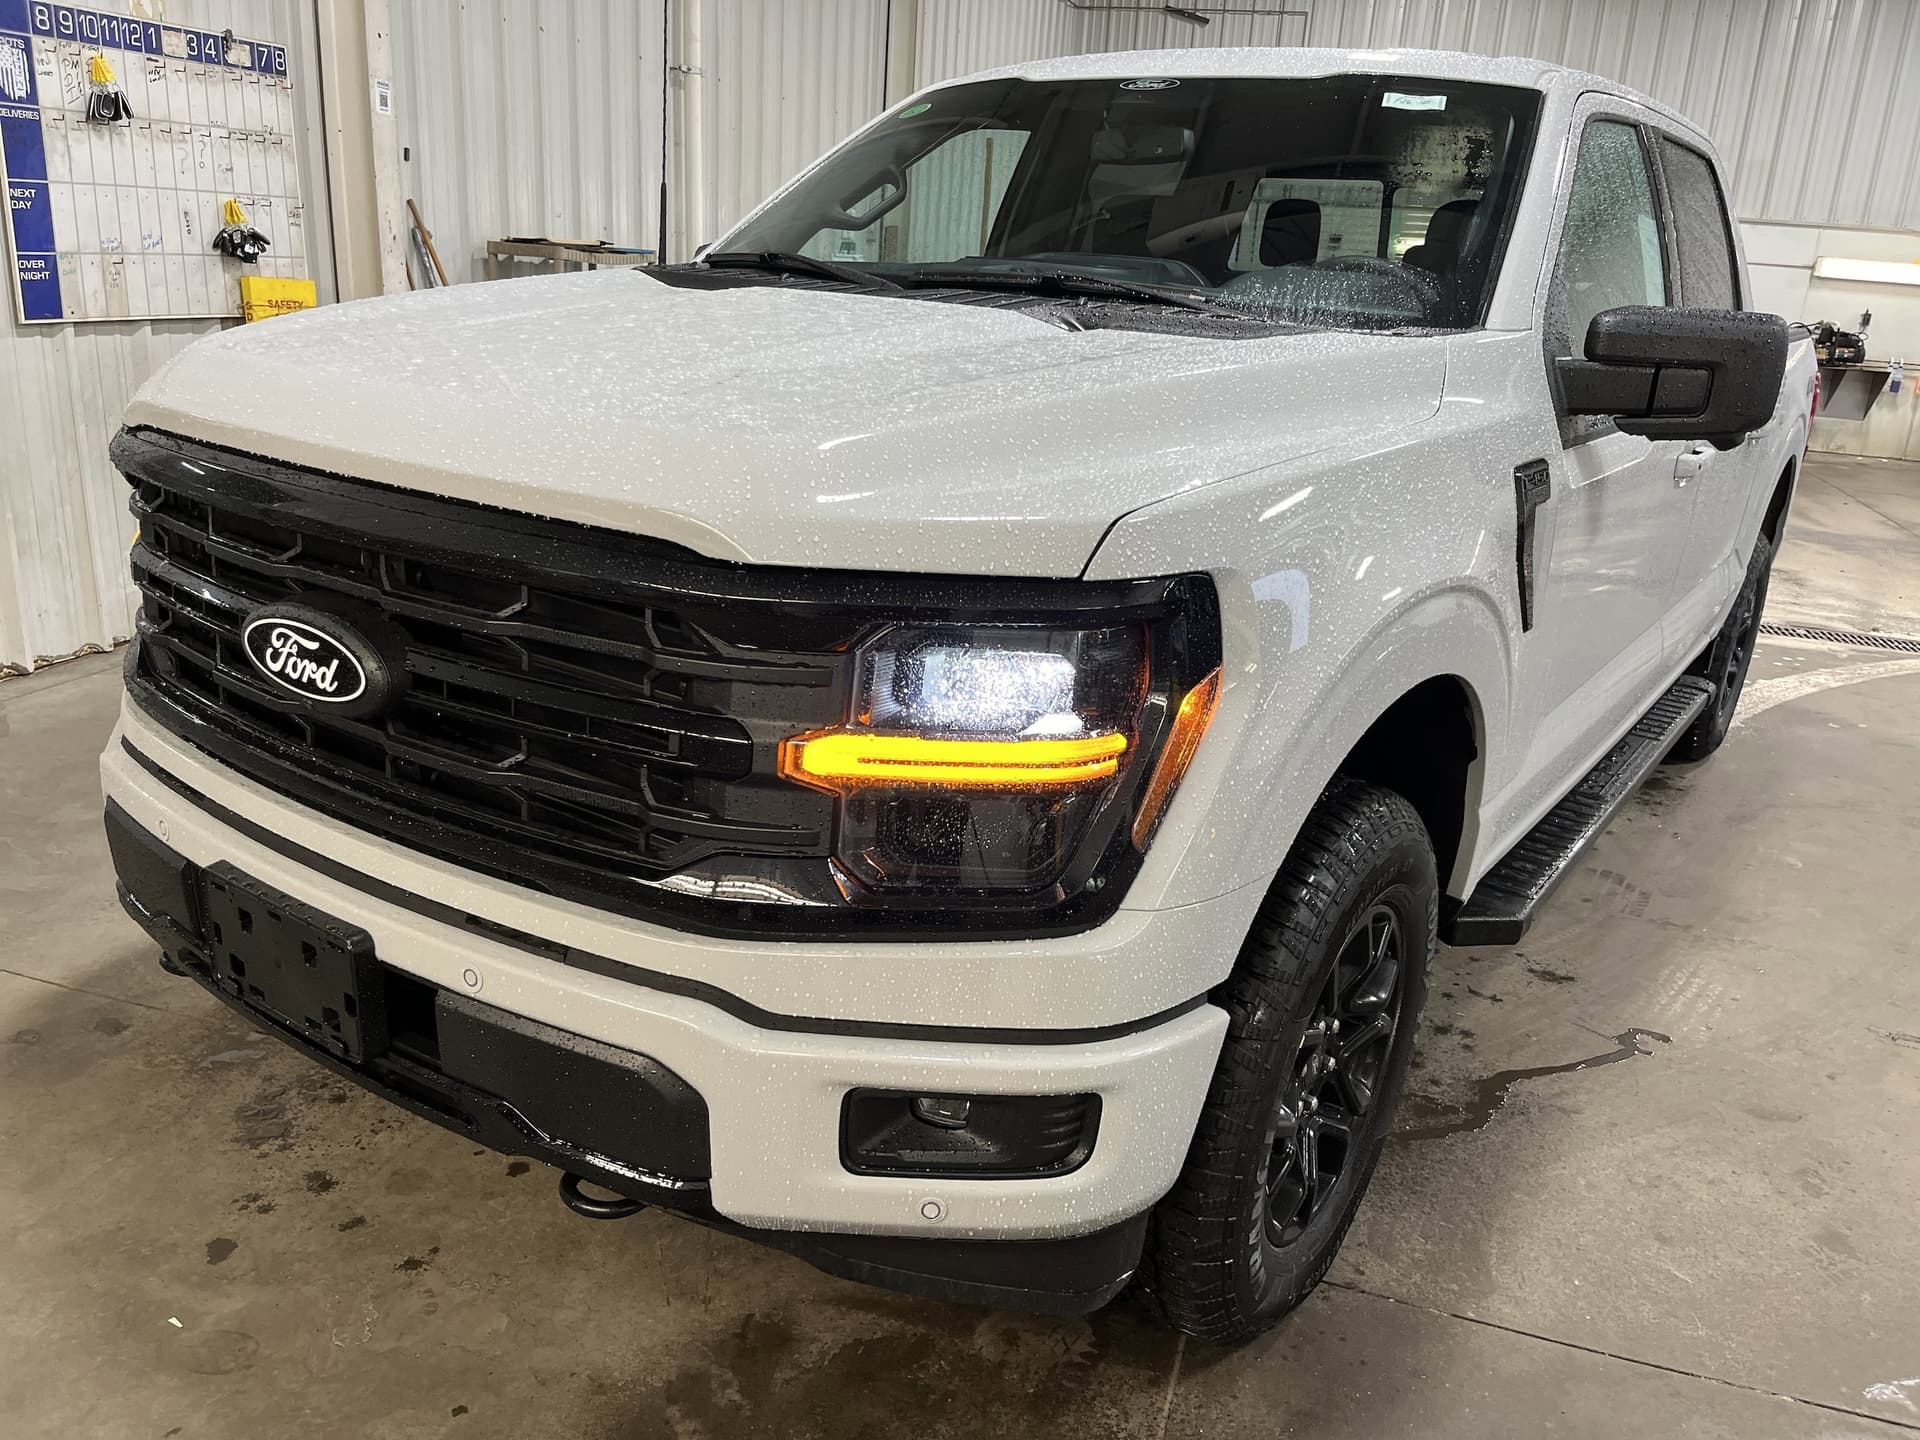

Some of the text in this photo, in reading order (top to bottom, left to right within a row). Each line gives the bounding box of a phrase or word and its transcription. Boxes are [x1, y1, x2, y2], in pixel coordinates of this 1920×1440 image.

[35, 6, 50, 31] 8
[59, 10, 74, 34] 9
[79, 13, 98, 39] 10
[100, 18, 120, 43] 11
[122, 22, 142, 47] 12
[147, 26, 157, 49] 1
[186, 34, 198, 56] 3
[204, 38, 217, 59] 4
[258, 47, 269, 67] 7
[275, 50, 286, 71] 8
[0, 107, 40, 120] DELIVERIES
[9, 188, 37, 198] NEXT
[11, 201, 33, 210] DAY
[18, 260, 46, 269] OVER
[20, 271, 51, 281] NIGHT
[267, 299, 304, 310] SAFETY
[265, 627, 340, 693] Ford
